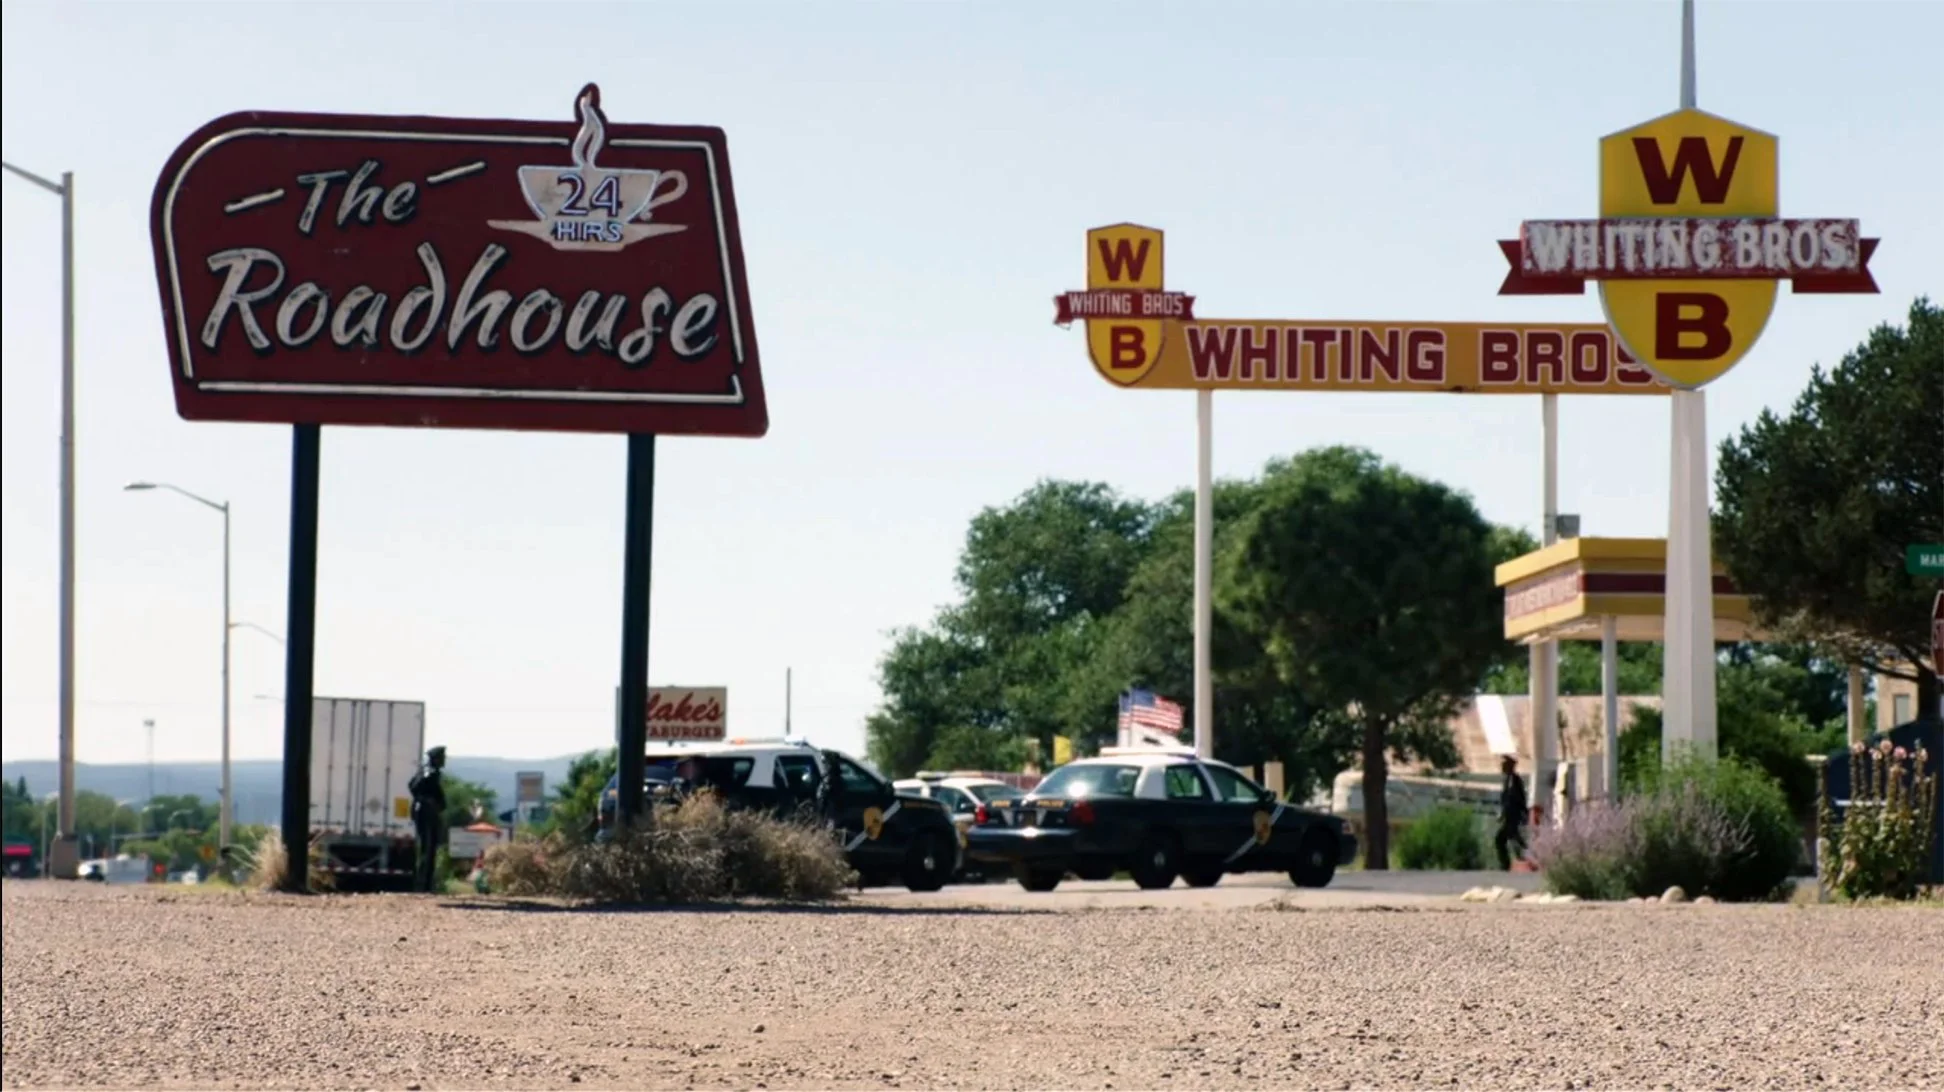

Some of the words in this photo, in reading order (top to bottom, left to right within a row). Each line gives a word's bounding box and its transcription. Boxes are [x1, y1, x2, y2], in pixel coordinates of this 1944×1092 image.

[1633, 136, 1744, 205] W
[296, 160, 417, 234] The
[557, 172, 623, 217] 24
[553, 221, 624, 243] HRS
[1528, 221, 1724, 272] WHITING
[1097, 238, 1151, 282] W
[200, 242, 718, 363] Roadhouse
[1068, 293, 1132, 315] WHITING
[1142, 295, 1183, 315] BROS
[1110, 326, 1146, 369] B
[1655, 293, 1731, 360] B
[1184, 325, 1447, 384] WHITING
[1479, 329, 1656, 386] BROS
[647, 691, 724, 722] lake's
[648, 726, 722, 738] ABURGER
